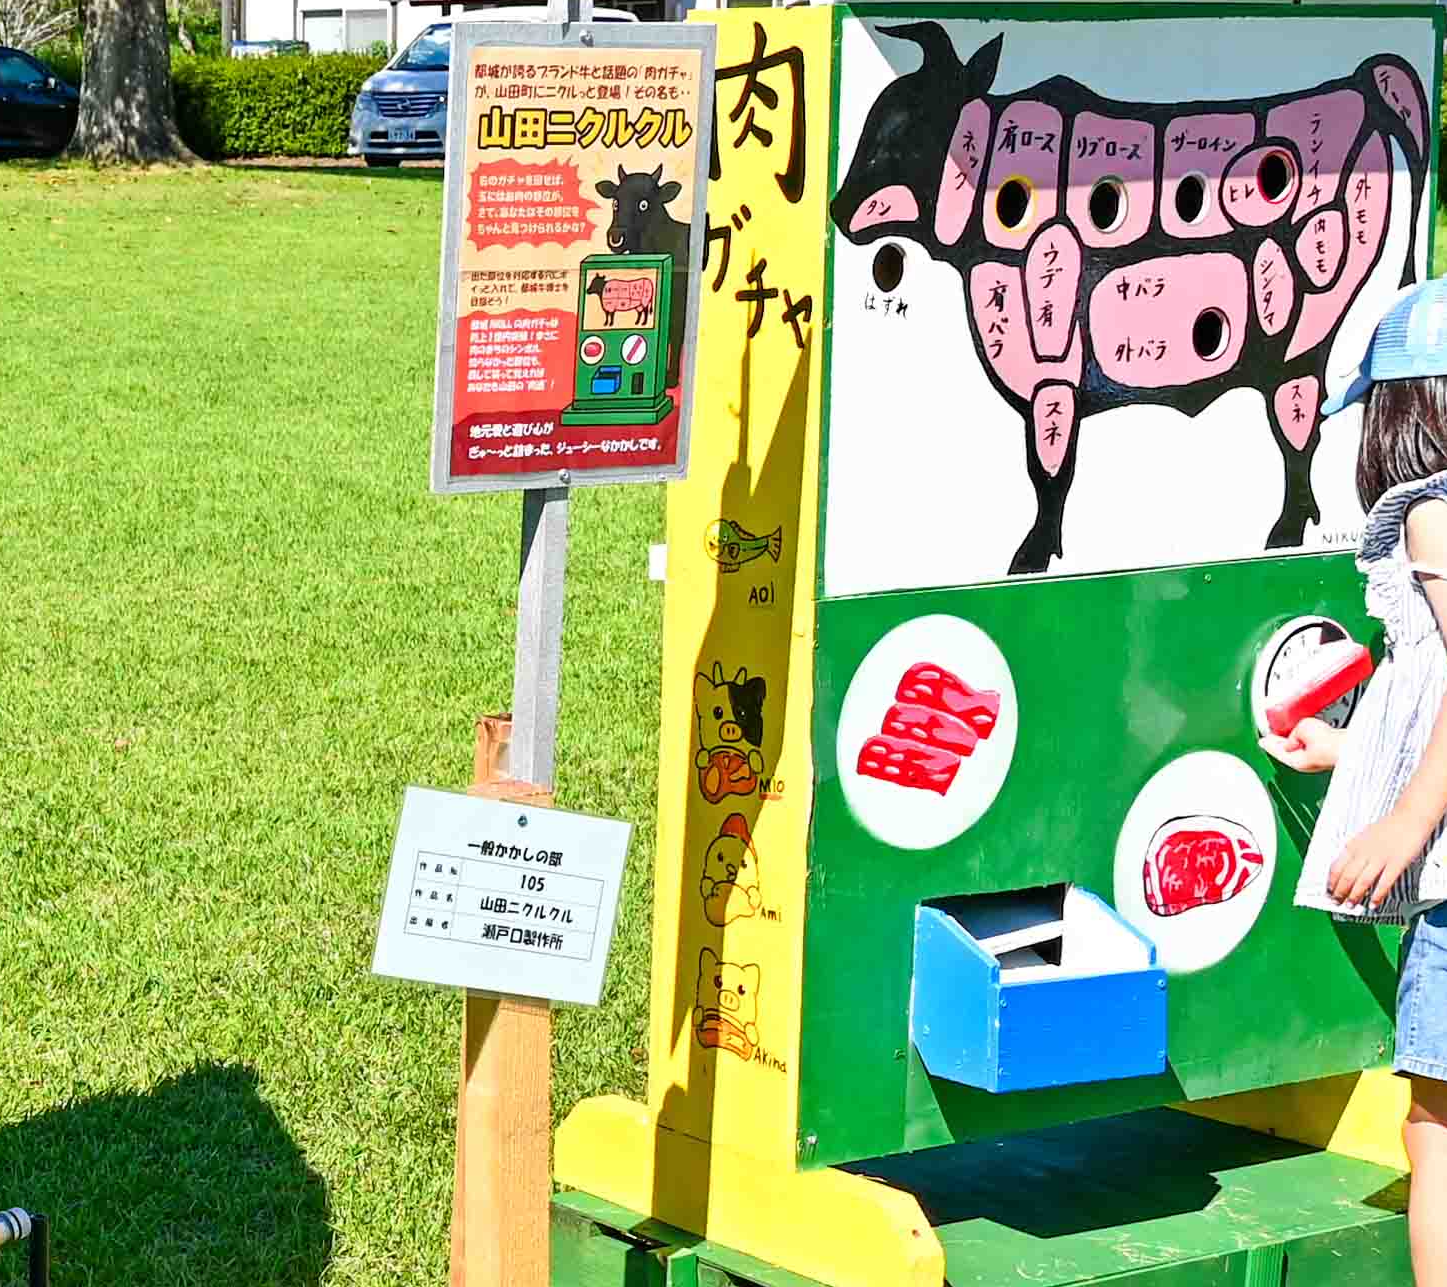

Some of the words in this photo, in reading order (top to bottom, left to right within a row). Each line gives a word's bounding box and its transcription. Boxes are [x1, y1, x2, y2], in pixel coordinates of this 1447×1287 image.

[478, 106, 692, 150] 山田ニクルクル
[997, 119, 1055, 154] 肩ロース
[954, 130, 979, 191] ネック
[1076, 135, 1142, 162] リブロース
[1309, 112, 1325, 206] ランイチ
[866, 199, 892, 217] タン
[1229, 183, 1256, 205] ヒレ
[1354, 170, 1373, 246] 外モモ
[1313, 217, 1330, 276] 内モモ
[1038, 240, 1062, 328] ウデ肩
[1115, 275, 1165, 300] 中バラ
[1259, 258, 1276, 339] シンタマ
[864, 291, 910, 320] はずれ
[985, 279, 1010, 360] 肩バラ
[1114, 339, 1169, 363] 外バラ
[1290, 383, 1308, 425] スネ
[1044, 400, 1064, 445] スネ
[467, 840, 563, 867] 一般かかしの部
[521, 874, 546, 892] 105
[480, 895, 573, 923] 山田ニクルクル
[481, 923, 564, 950] 瀬戸口製作所
